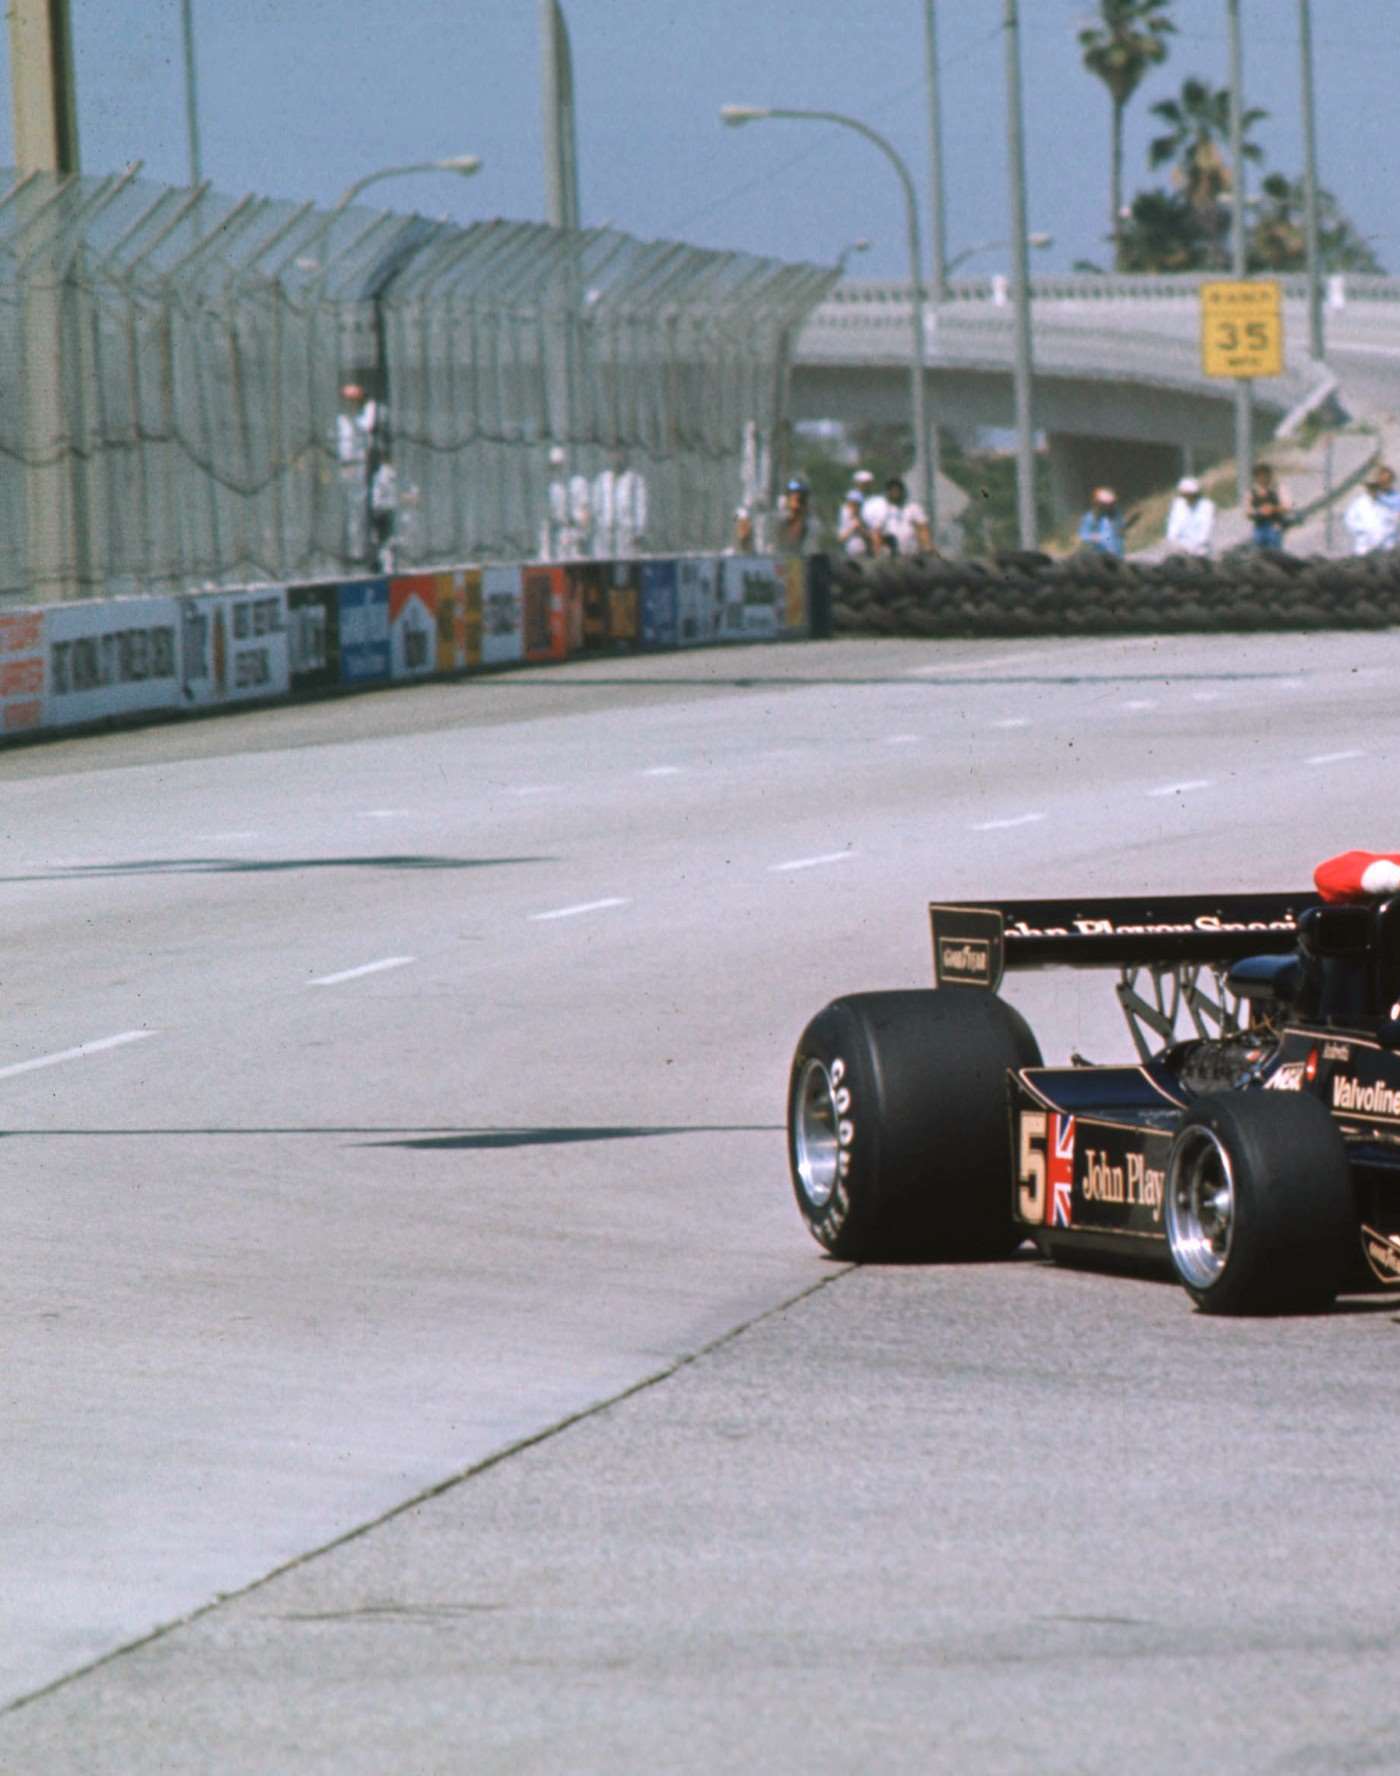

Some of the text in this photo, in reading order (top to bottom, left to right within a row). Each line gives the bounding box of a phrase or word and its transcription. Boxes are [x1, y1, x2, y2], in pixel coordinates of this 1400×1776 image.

[1216, 322, 1268, 351] 35
[1019, 1110, 1165, 1225] 5 John Play
